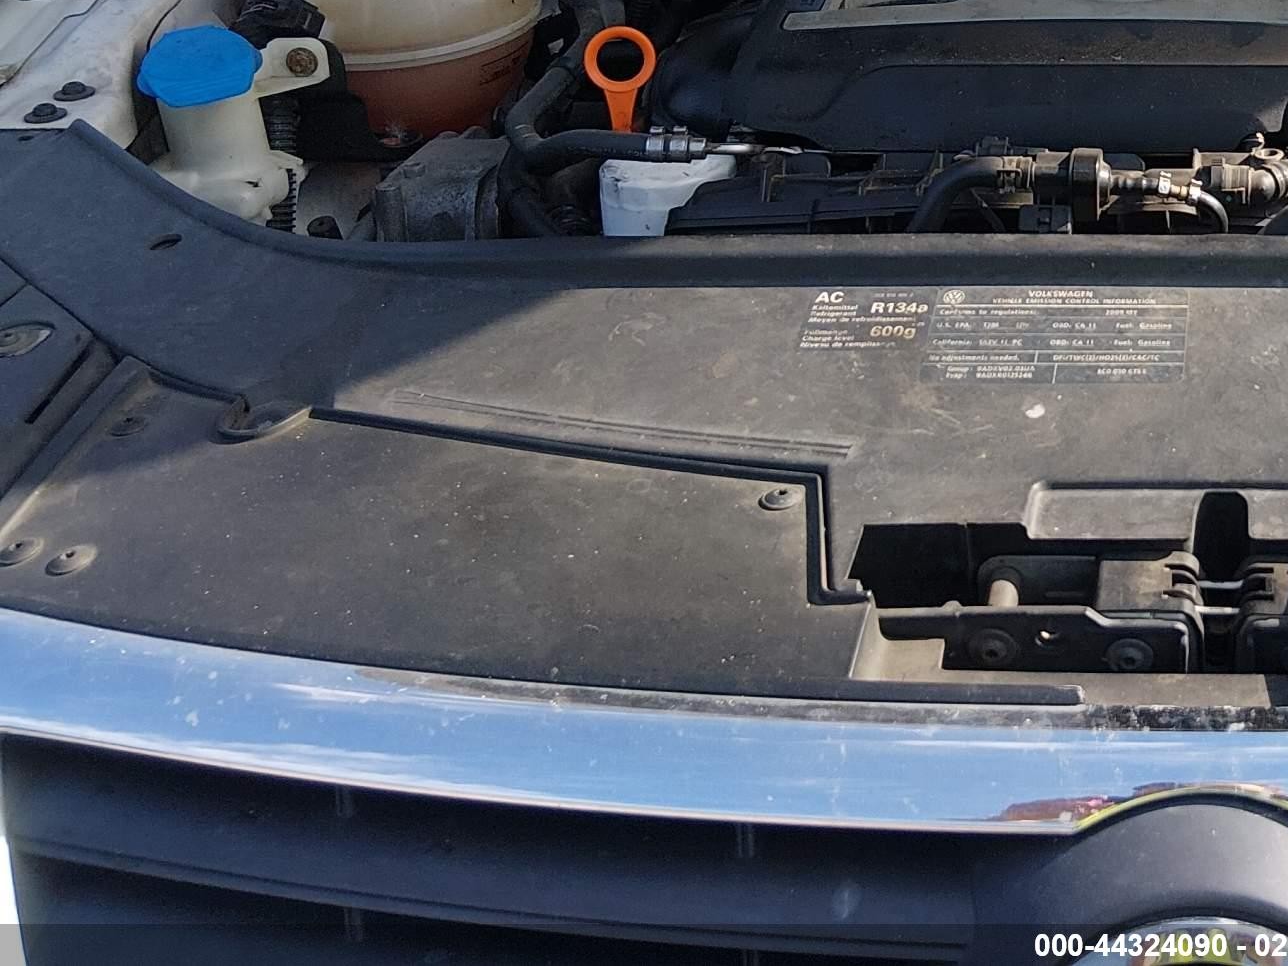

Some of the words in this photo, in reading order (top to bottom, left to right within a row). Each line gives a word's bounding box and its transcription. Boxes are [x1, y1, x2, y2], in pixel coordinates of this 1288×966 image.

[814, 291, 845, 303] AC
[1028, 290, 1094, 298] VOLKSWAGEN
[870, 302, 929, 314] R134a
[870, 325, 917, 339] 600g
